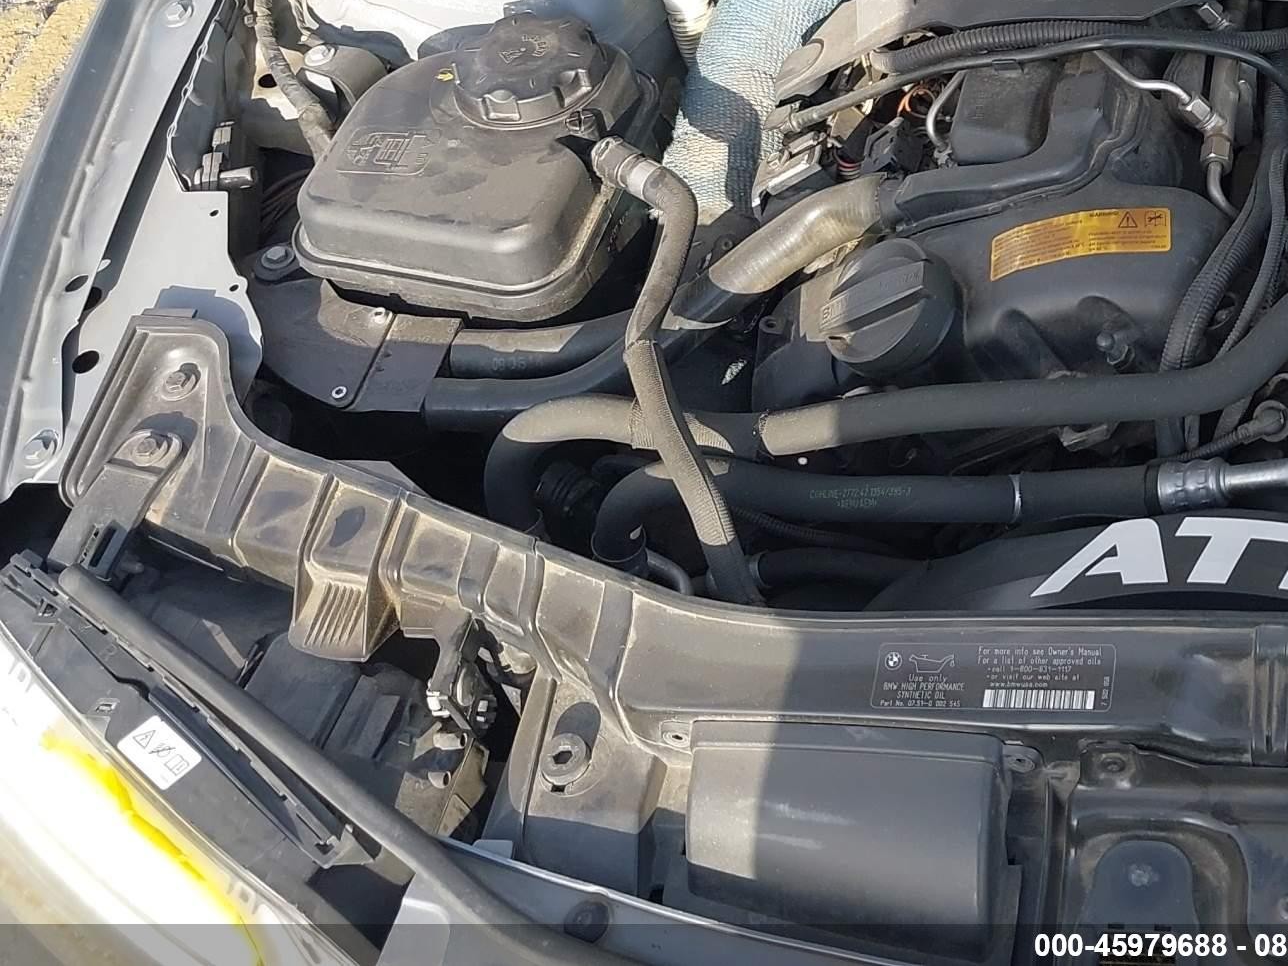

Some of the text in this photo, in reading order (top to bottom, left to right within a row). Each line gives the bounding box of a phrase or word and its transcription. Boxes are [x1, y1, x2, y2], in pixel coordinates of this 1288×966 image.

[978, 646, 990, 654] For
[1014, 646, 1028, 654] info
[1048, 646, 1074, 656] Owner's
[1078, 646, 1102, 656] Manual
[978, 656, 990, 664] For
[1002, 656, 1014, 664] list
[1018, 656, 1026, 664] of
[1030, 656, 1048, 664] other
[1052, 657, 1084, 666] approved
[1088, 657, 1101, 665] oils
[908, 674, 948, 684] Use only
[883, 682, 966, 691] BMW HIGH PERFORMANCE
[896, 690, 946, 700] SYNTHETIC OIL
